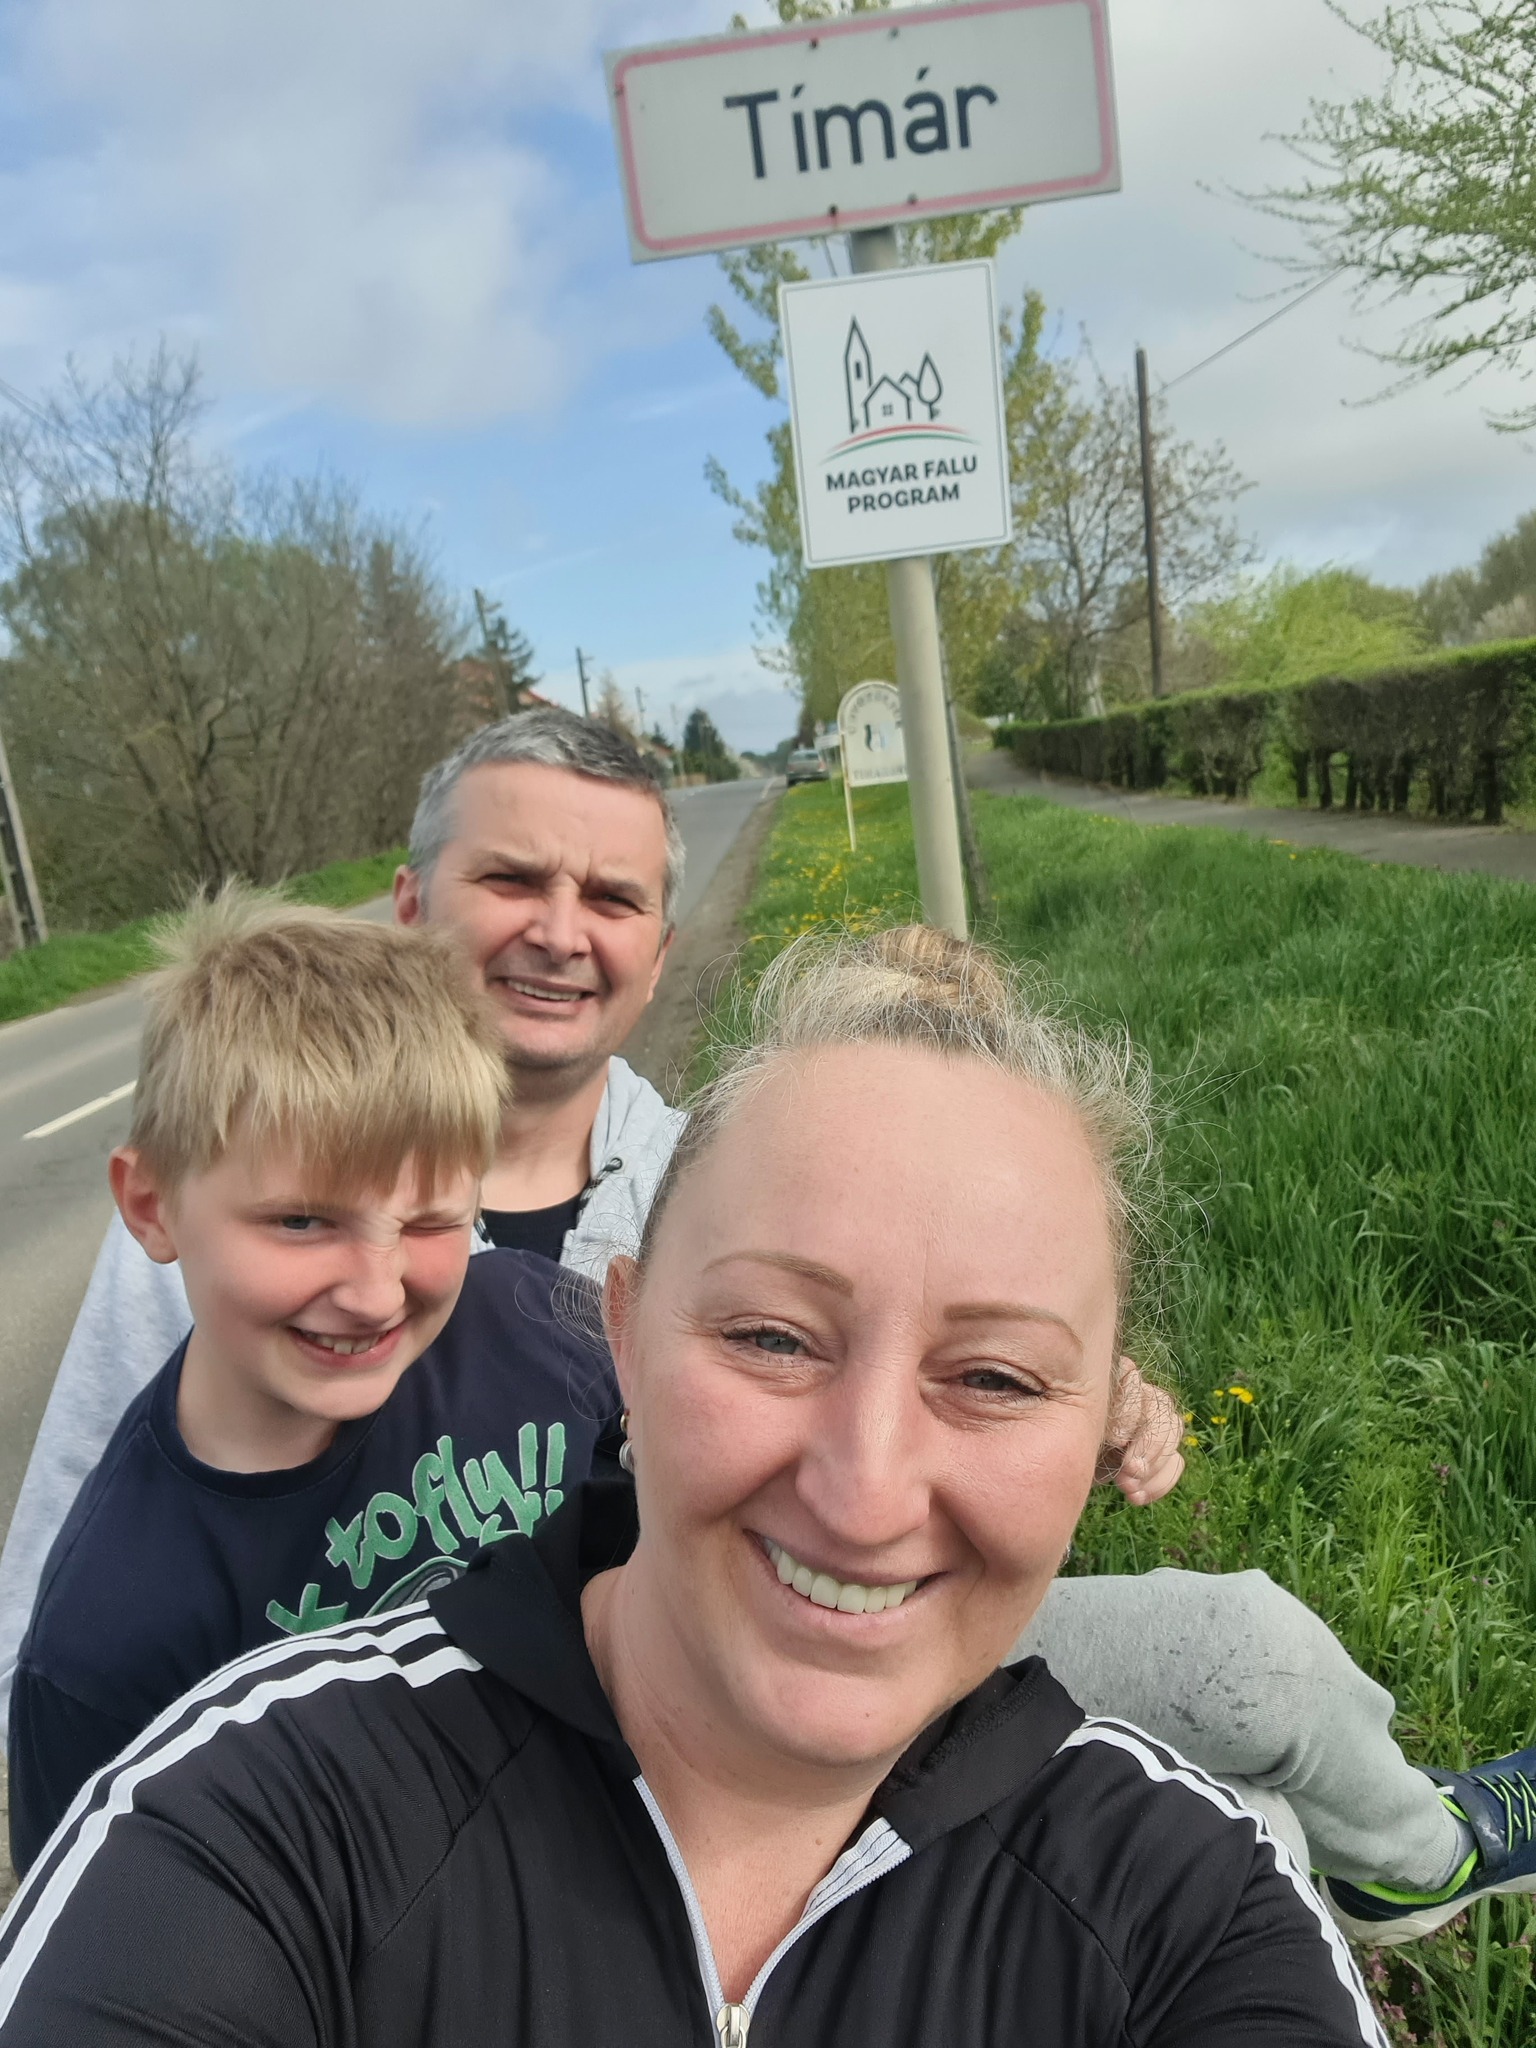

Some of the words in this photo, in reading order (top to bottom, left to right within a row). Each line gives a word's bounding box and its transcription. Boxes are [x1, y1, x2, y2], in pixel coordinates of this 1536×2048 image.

[724, 66, 998, 179] Tímár
[826, 463, 919, 491] MAGYAR
[924, 455, 978, 479] FALU
[847, 482, 960, 514] PROGRAM
